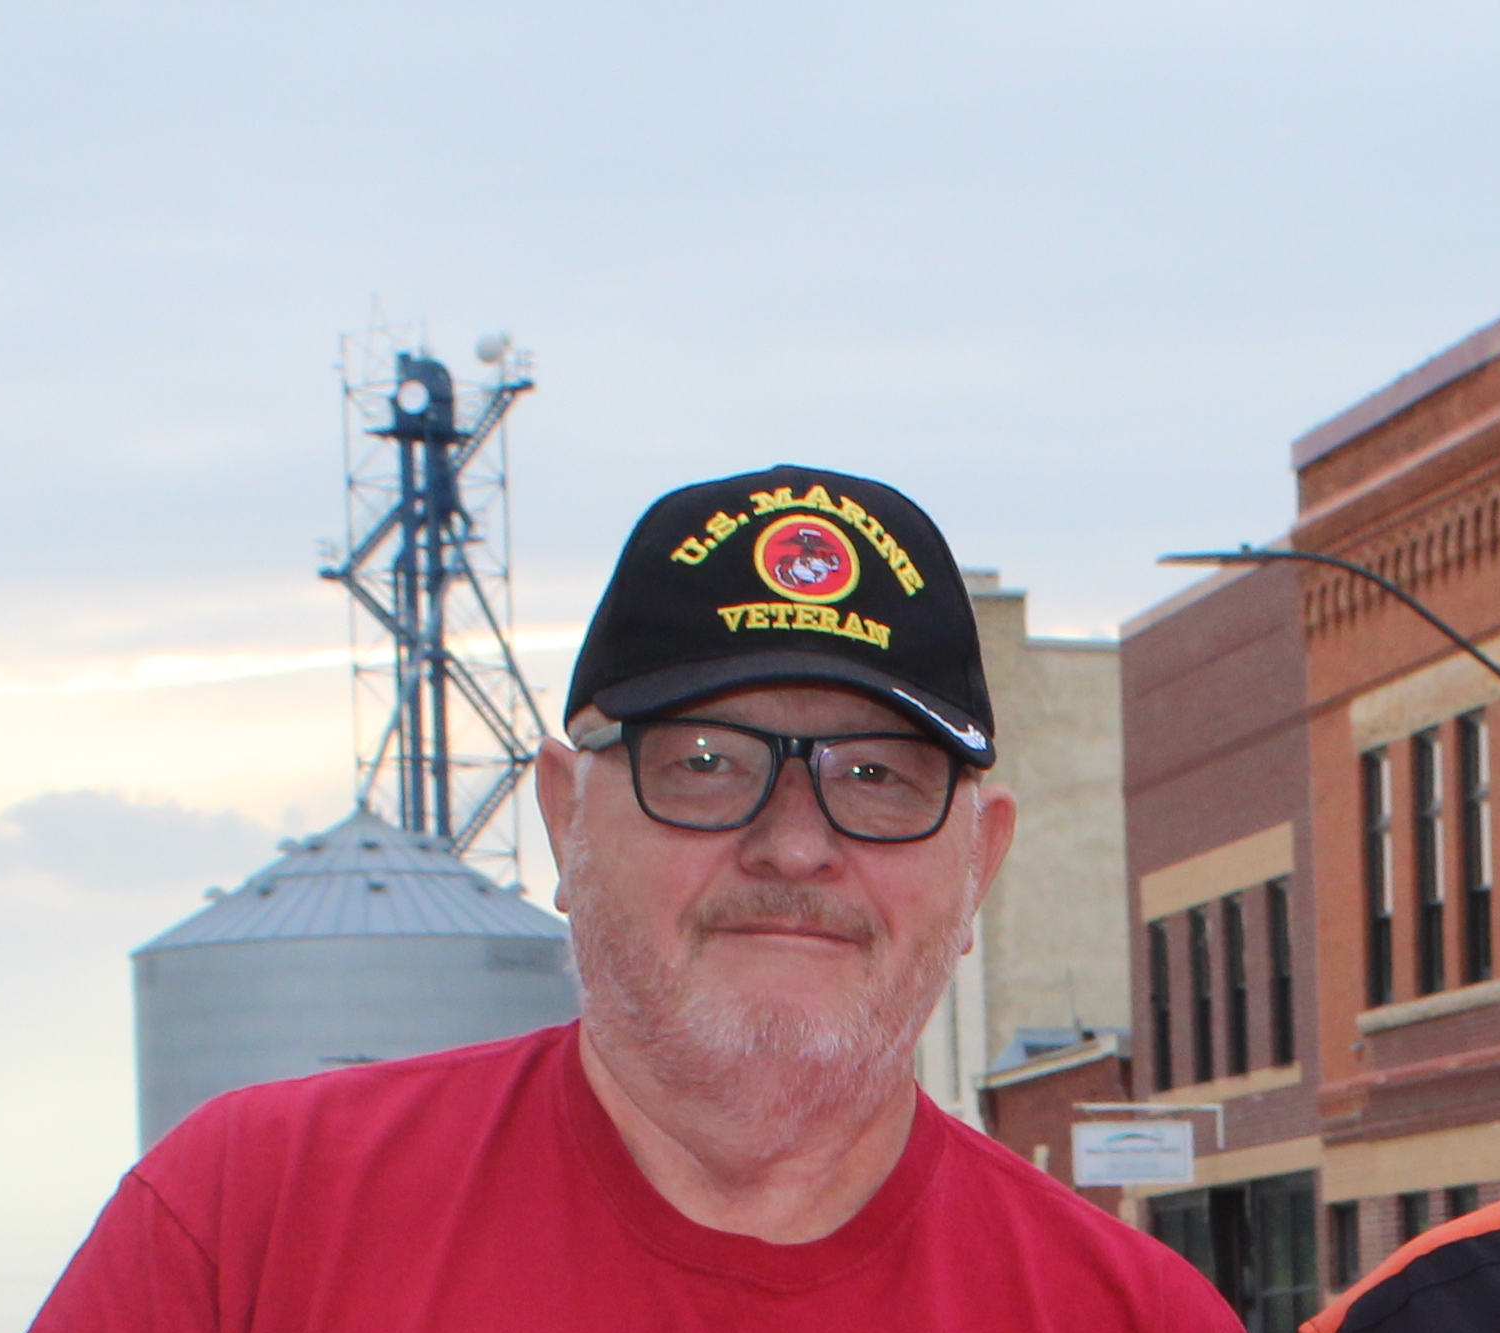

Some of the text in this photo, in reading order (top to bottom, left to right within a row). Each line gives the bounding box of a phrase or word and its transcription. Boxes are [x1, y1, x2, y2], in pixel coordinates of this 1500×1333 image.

[670, 484, 926, 598] U.S. MARINE
[717, 602, 892, 650] VETERAN
